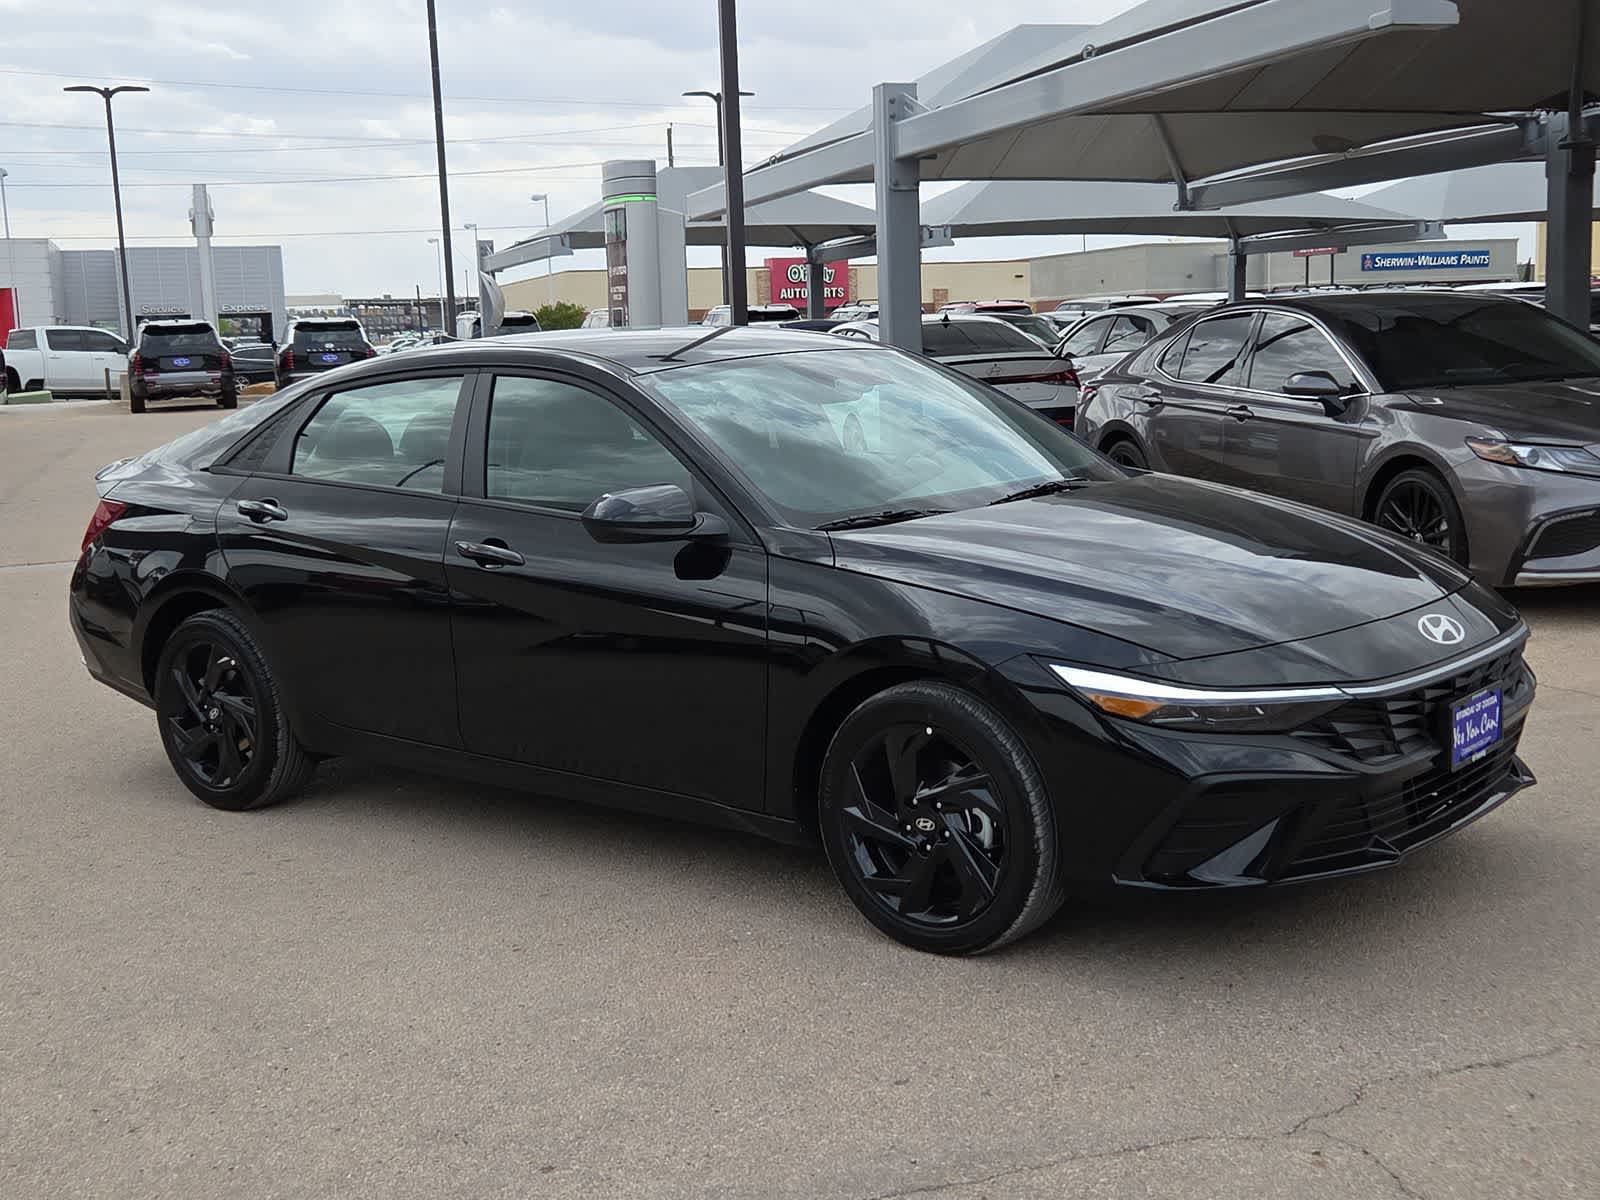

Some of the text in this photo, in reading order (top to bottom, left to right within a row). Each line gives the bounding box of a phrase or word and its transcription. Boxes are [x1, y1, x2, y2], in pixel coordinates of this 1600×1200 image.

[1374, 254, 1490, 268] SHERWIN-WILLIAMS PAINTS
[780, 287, 844, 299] AUTO RTS
[141, 304, 268, 313] Service Express
[1453, 726, 1465, 748] Yes
[1466, 720, 1479, 741] You
